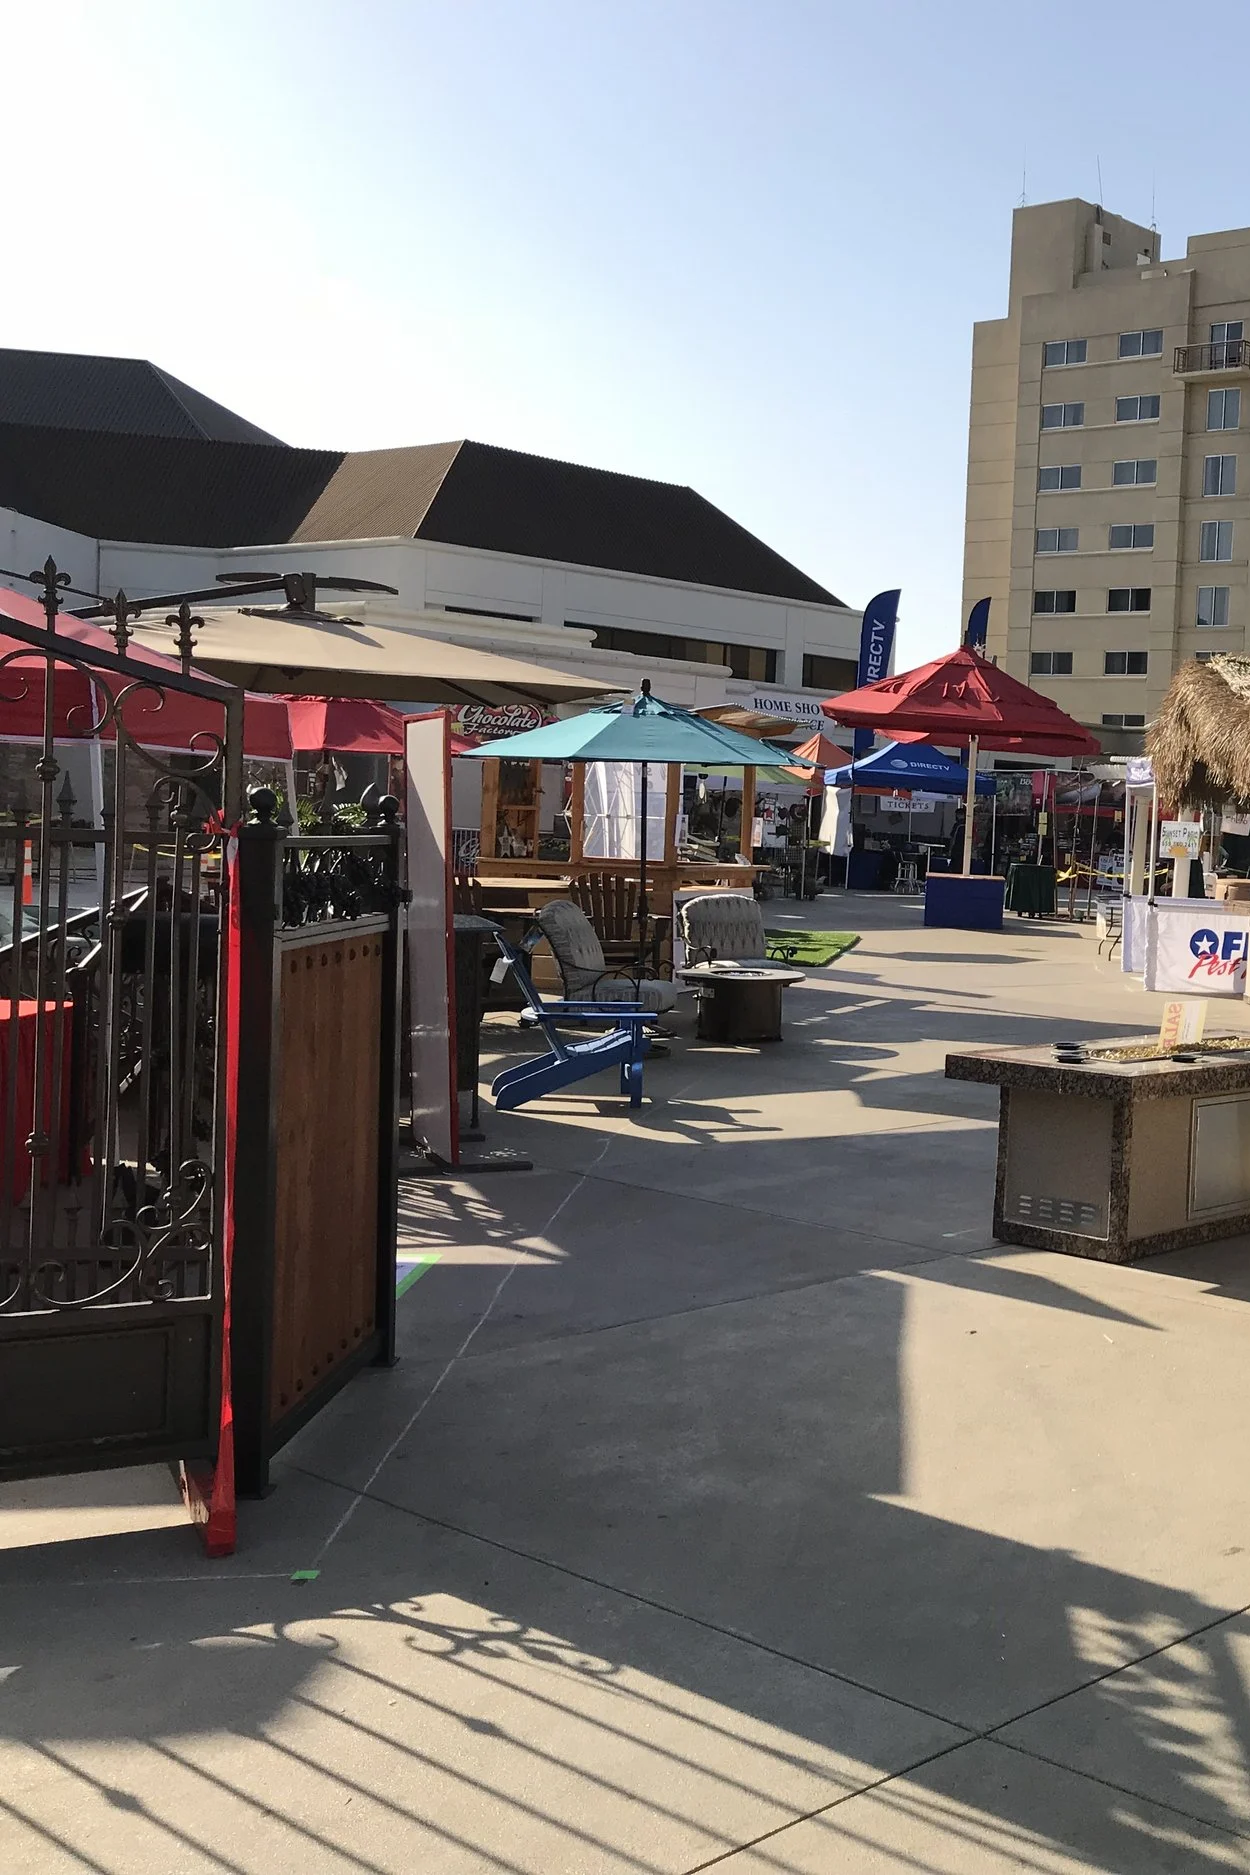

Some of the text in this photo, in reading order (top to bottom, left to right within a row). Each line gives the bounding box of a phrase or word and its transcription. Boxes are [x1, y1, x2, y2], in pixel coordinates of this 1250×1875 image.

[866, 618, 885, 683] IRECTV
[457, 703, 540, 730] Chocolate
[753, 697, 820, 715] HOME SHO
[910, 761, 950, 771] DIRECTV
[887, 800, 929, 810] TICKETS
[1187, 953, 1243, 979] Pest
